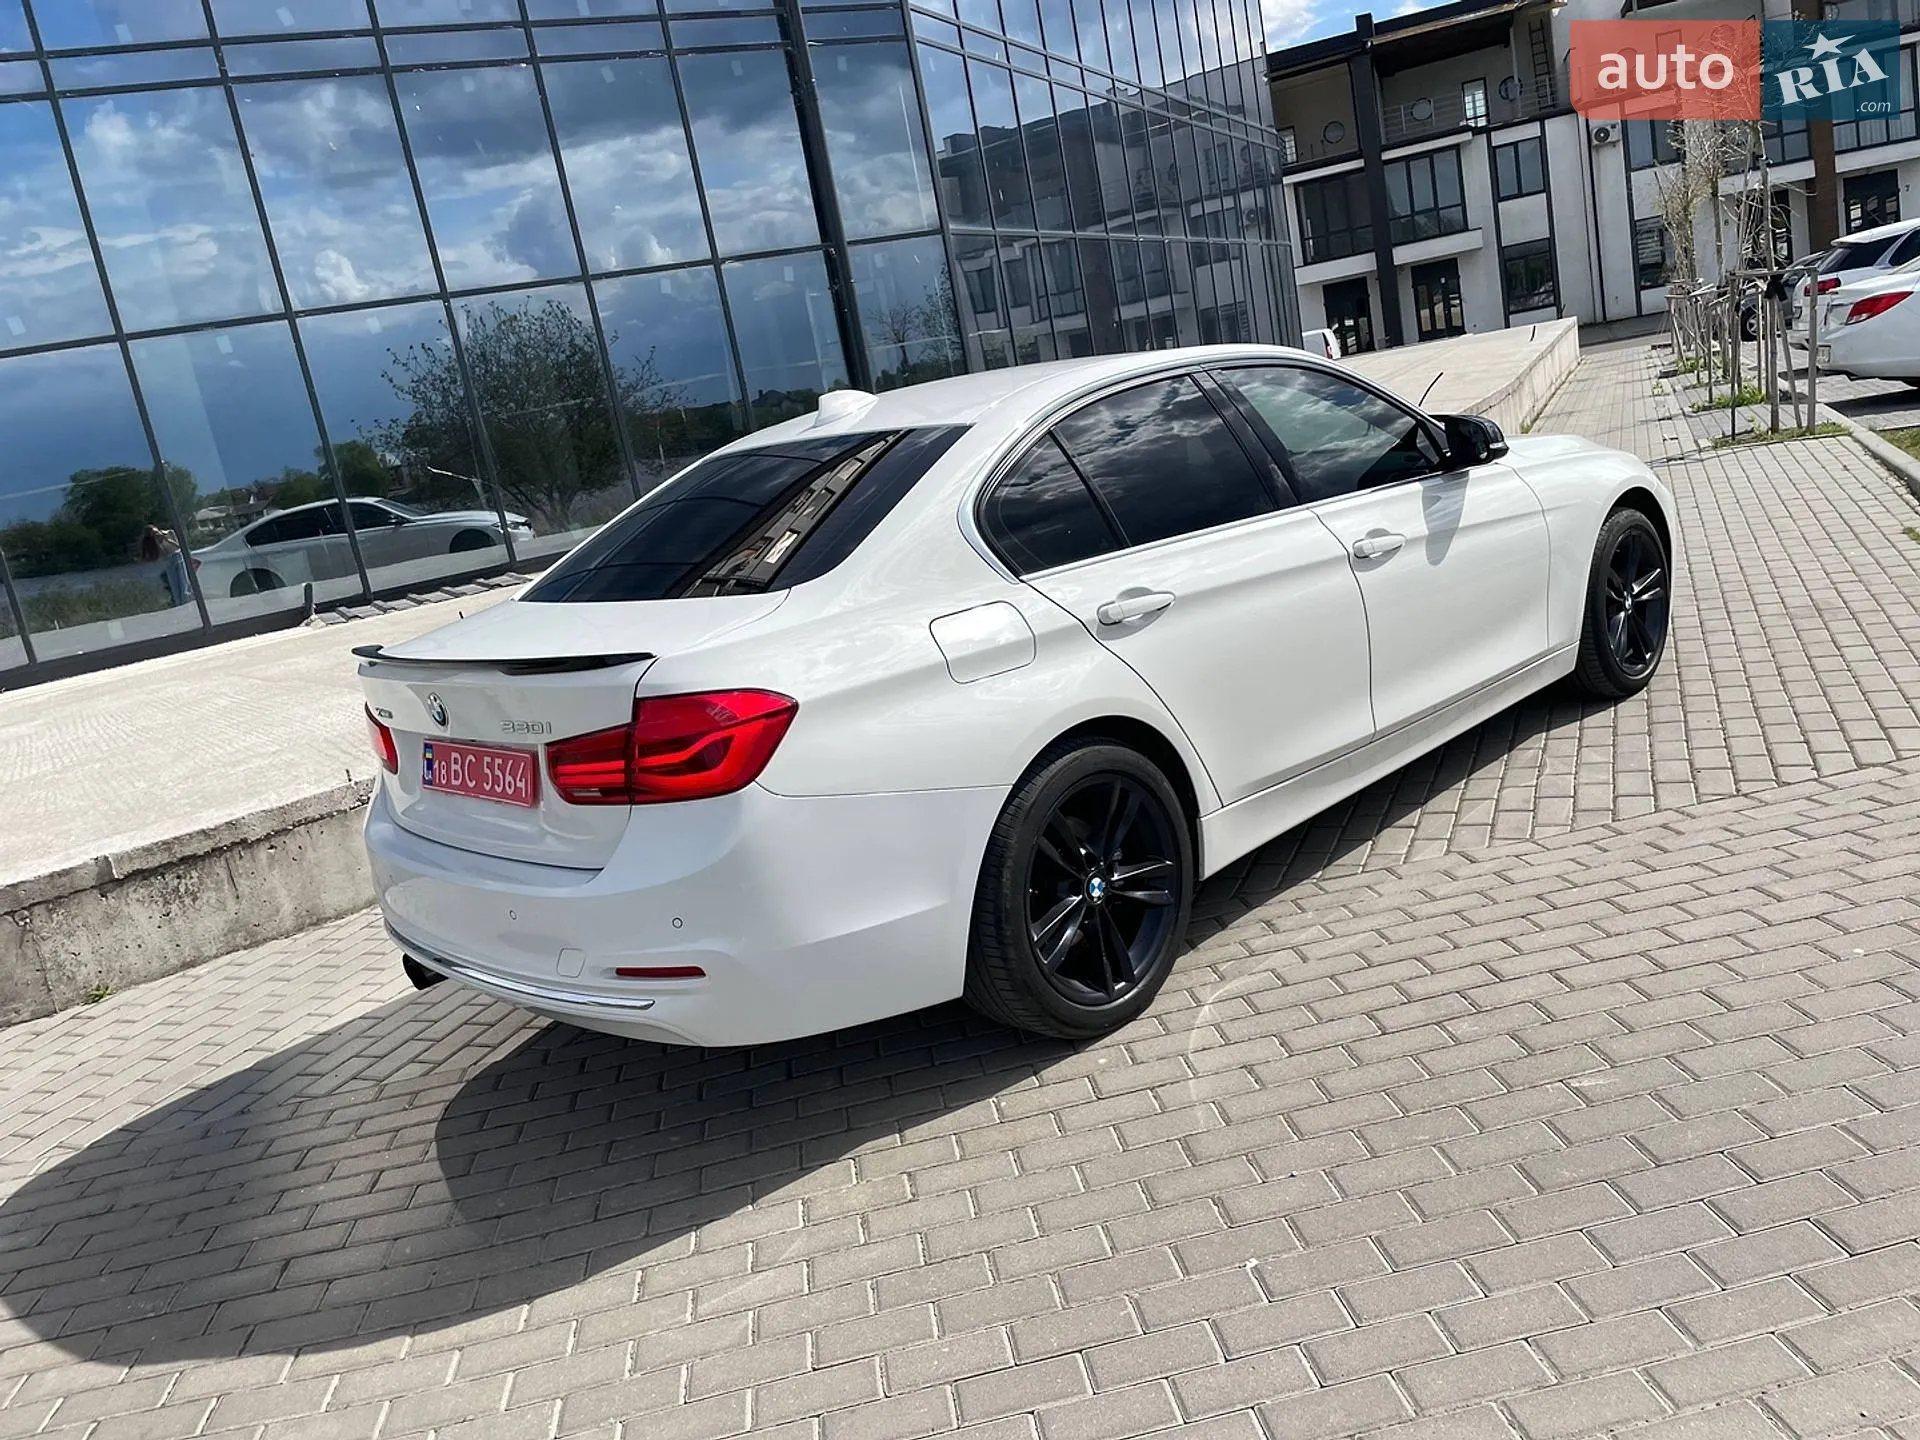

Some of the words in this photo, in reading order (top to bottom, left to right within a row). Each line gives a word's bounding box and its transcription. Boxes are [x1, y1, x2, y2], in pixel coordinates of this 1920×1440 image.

[433, 759, 448, 785] 18
[451, 751, 477, 789] BC
[483, 755, 526, 799] 5564
